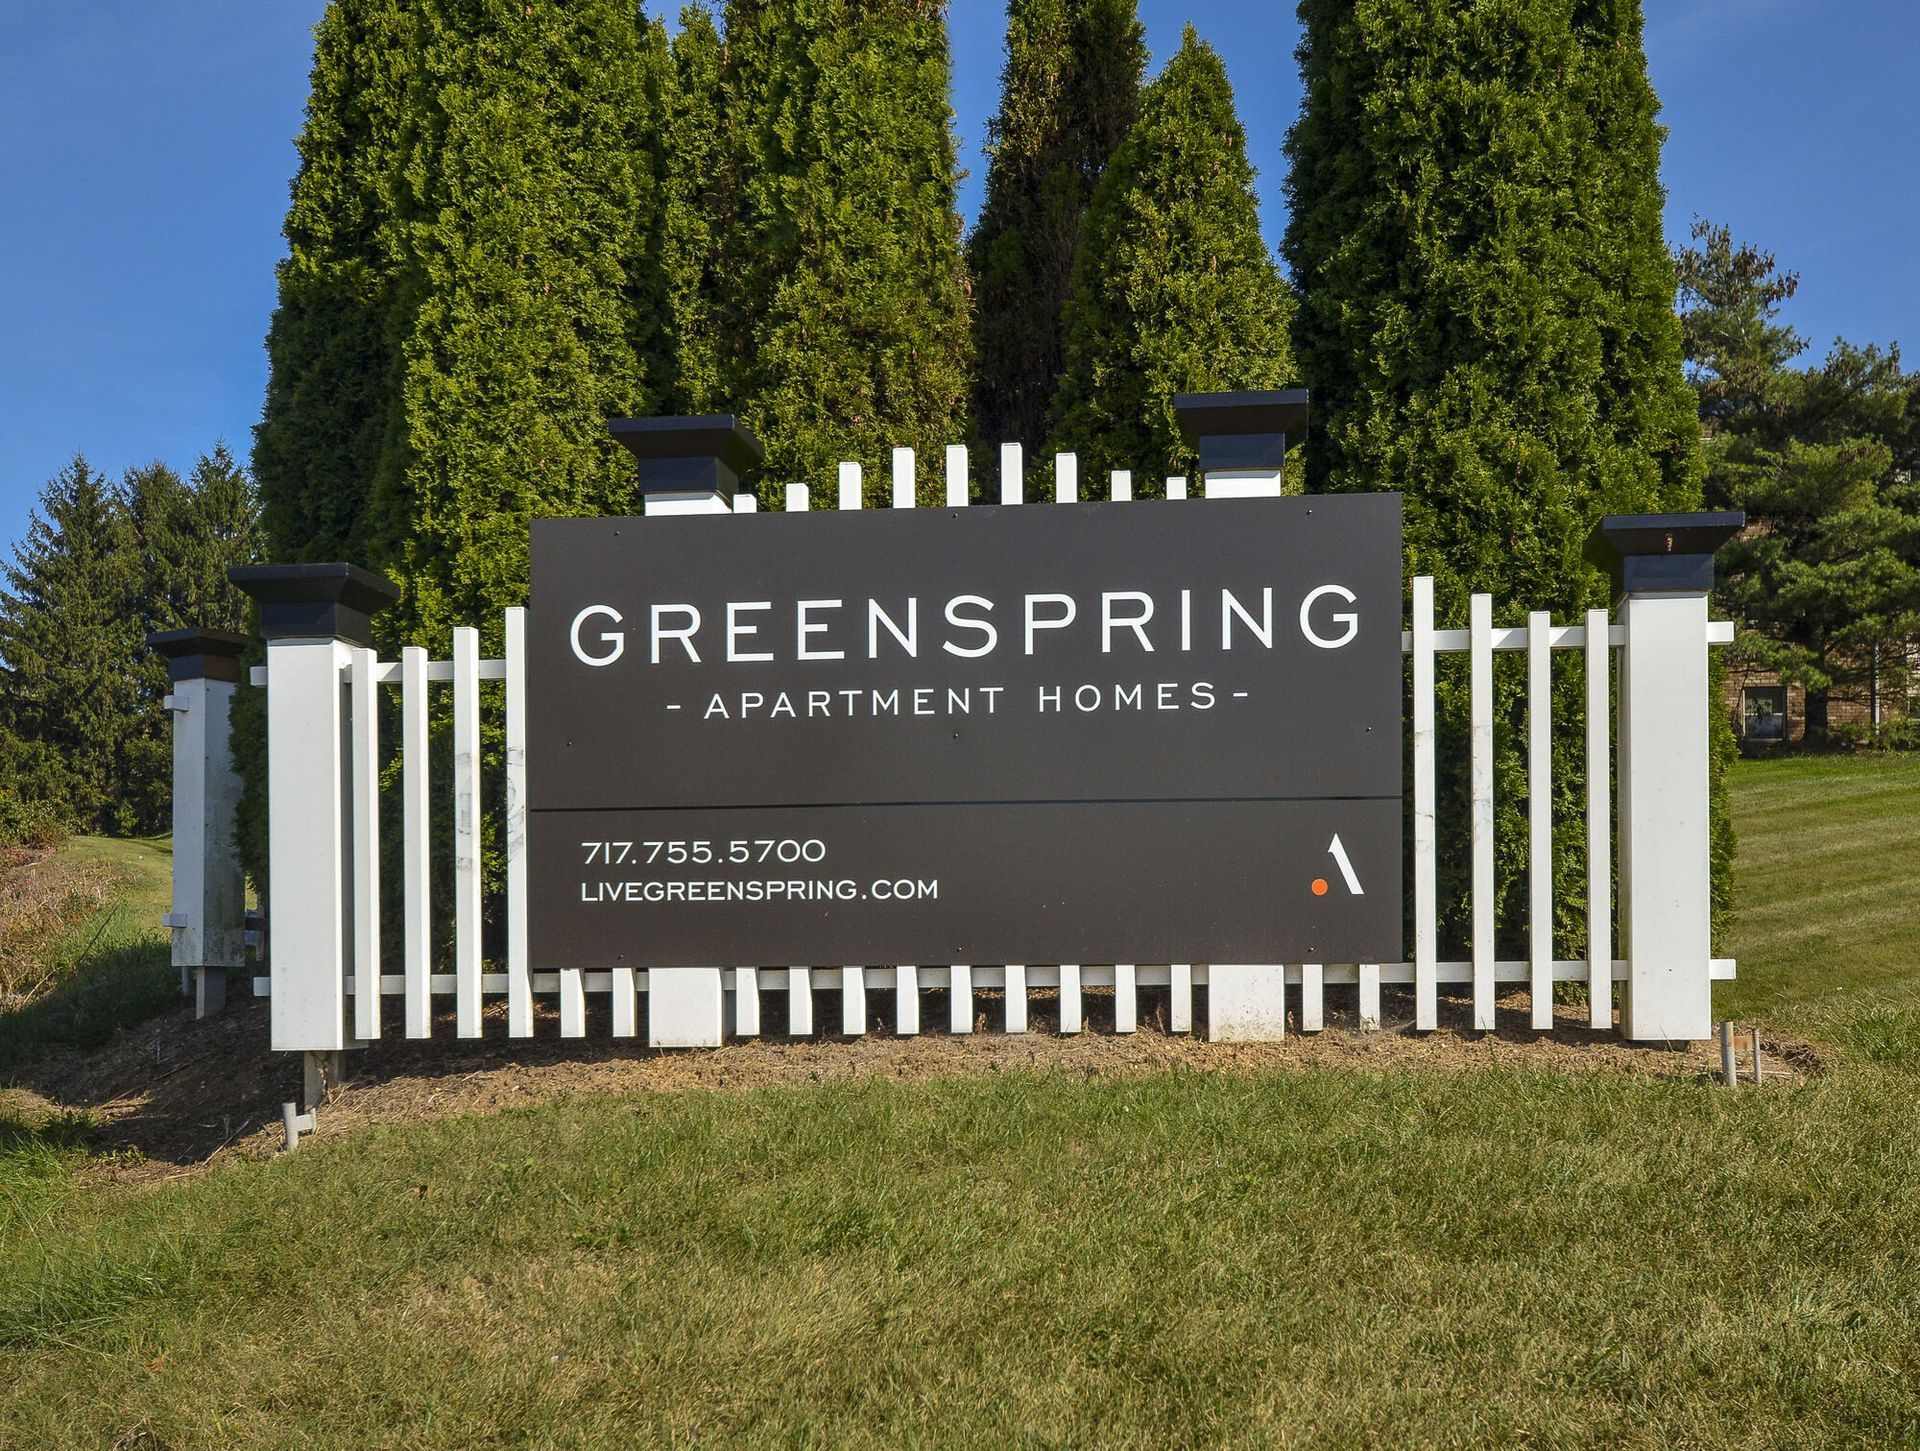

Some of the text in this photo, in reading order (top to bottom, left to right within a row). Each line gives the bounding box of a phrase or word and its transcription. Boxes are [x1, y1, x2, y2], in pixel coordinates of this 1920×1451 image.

[569, 584, 1360, 668] GREENSPRING
[702, 686, 1005, 721] APARTMENT
[1037, 681, 1217, 713] HOMES
[581, 839, 827, 865] 717.755.5700
[580, 879, 939, 903] LIVEGREENSPRING.COM
